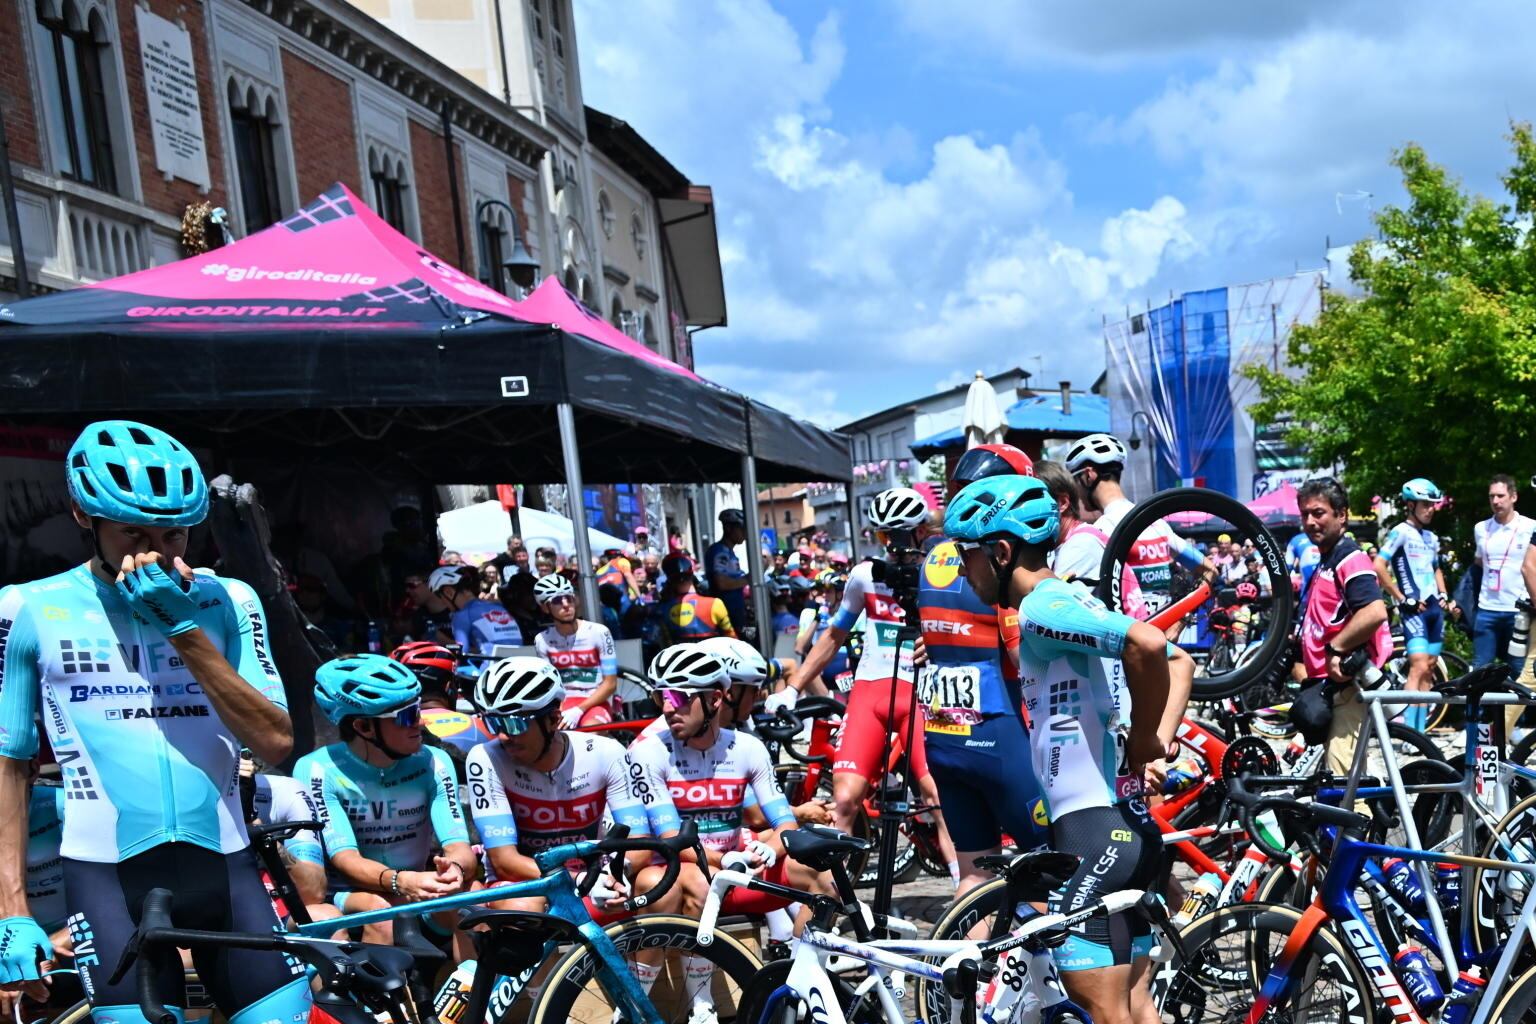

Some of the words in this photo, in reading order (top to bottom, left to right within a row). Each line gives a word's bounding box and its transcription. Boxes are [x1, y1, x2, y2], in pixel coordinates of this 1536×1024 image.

[201, 263, 377, 287] #giroditalia
[127, 305, 387, 318] GIRODITALIA.IT
[980, 498, 1008, 526] BRIKO
[1257, 533, 1282, 576] AEOLUS
[1141, 567, 1172, 581] KOME
[248, 612, 278, 677] FAIZANE
[1036, 624, 1098, 648] FAIZANE
[940, 674, 976, 709] 113
[1113, 657, 1121, 711] DIANI
[46, 696, 68, 735] GROUP
[122, 704, 210, 721] FAIZANE
[1050, 746, 1061, 778] GROUP
[1481, 749, 1498, 785] 158
[441, 776, 462, 821] FAIZANE
[515, 801, 598, 825] POLTI
[681, 811, 739, 822] OMETA
[1093, 845, 1119, 875] CSF
[74, 937, 100, 967] VF
[81, 965, 96, 995] GROUP
[1001, 954, 1028, 992] 88
